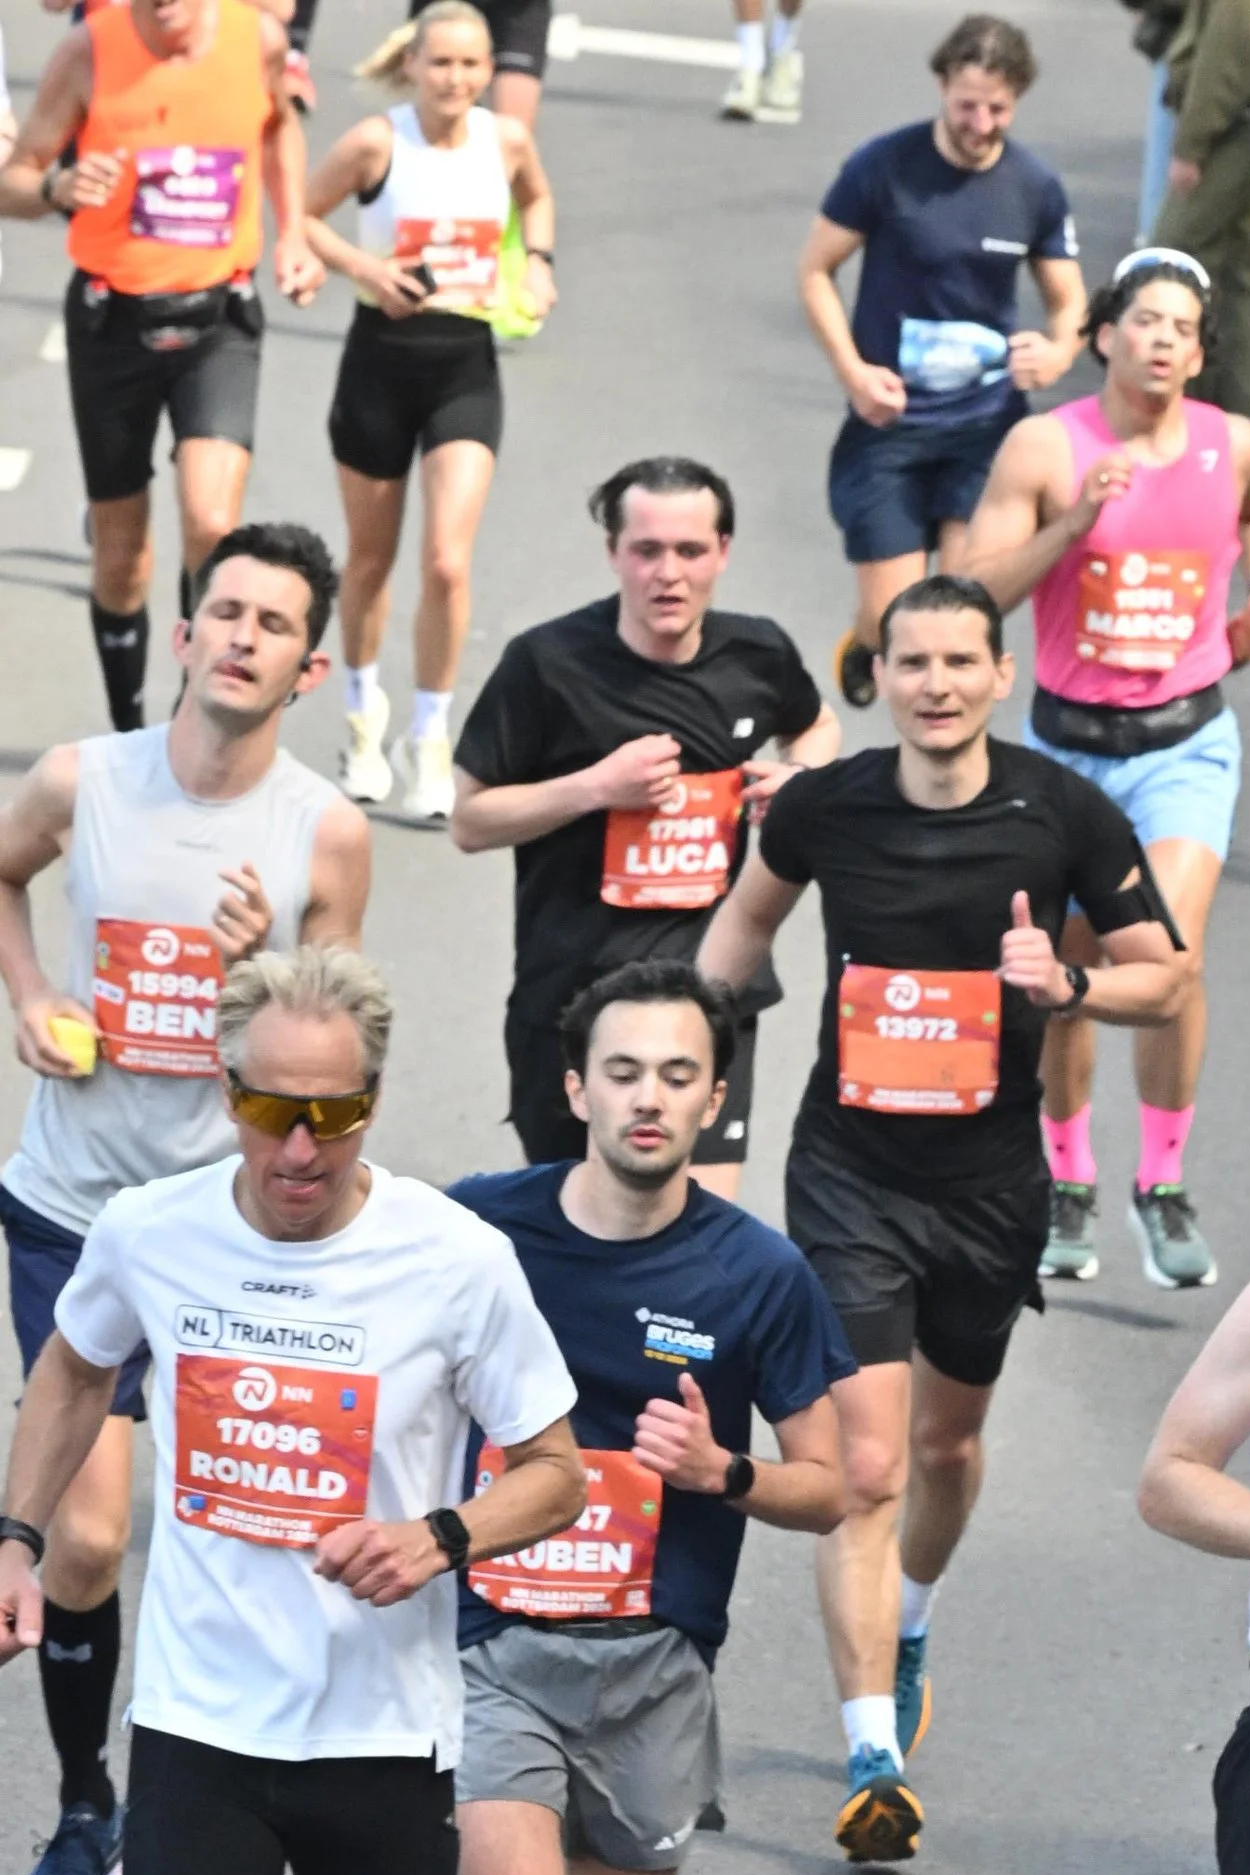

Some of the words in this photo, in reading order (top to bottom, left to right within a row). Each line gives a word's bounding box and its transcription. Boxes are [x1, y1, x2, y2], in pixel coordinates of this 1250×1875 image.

[1085, 611, 1194, 640] MARCO
[624, 842, 729, 875] LUCA
[128, 971, 217, 1000] 15994
[124, 1000, 216, 1039] BEN
[875, 1015, 957, 1040] 13972
[241, 1281, 300, 1296] CRAFT
[182, 1316, 210, 1336] NL
[229, 1321, 355, 1353] TRIATHLON
[281, 1385, 314, 1403] NN
[216, 1417, 321, 1456] 17096
[189, 1450, 348, 1500] RONALD
